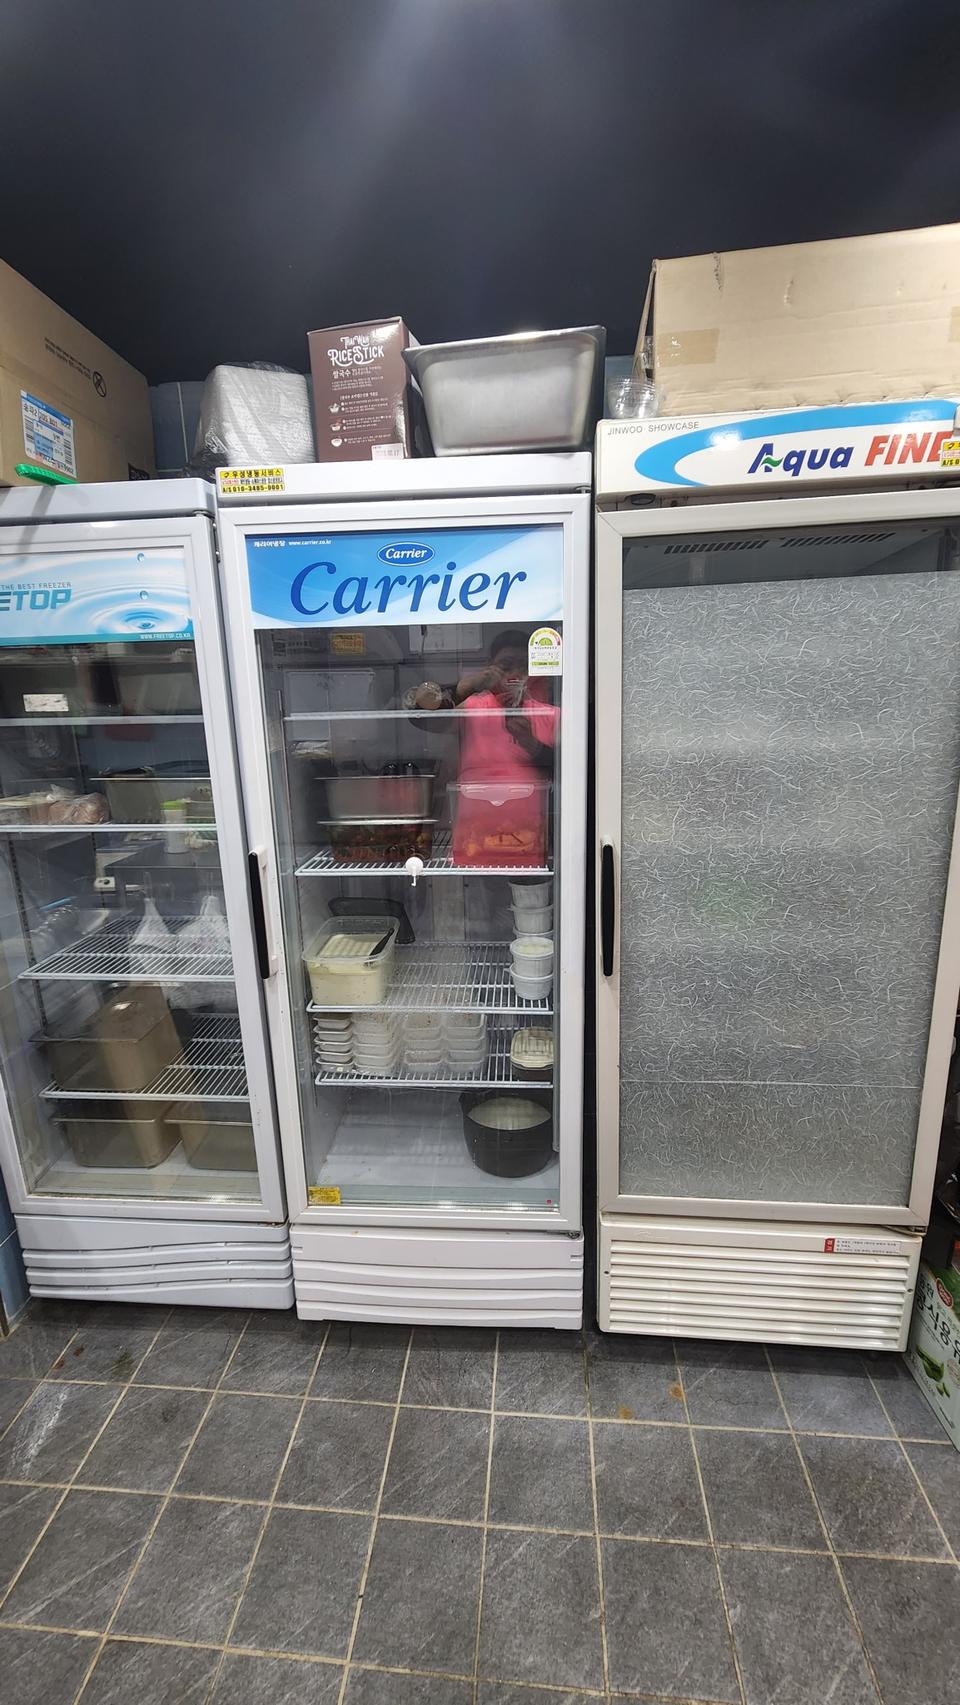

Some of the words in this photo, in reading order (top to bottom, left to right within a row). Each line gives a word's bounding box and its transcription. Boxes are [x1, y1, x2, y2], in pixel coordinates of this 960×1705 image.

[607, 425, 643, 435] JINWOO
[648, 421, 700, 433] SHOWCASE
[747, 443, 854, 477] Aqua
[385, 547, 428, 560] Carrier
[38, 581, 72, 589] FREEZER
[290, 560, 528, 616] Carrier
